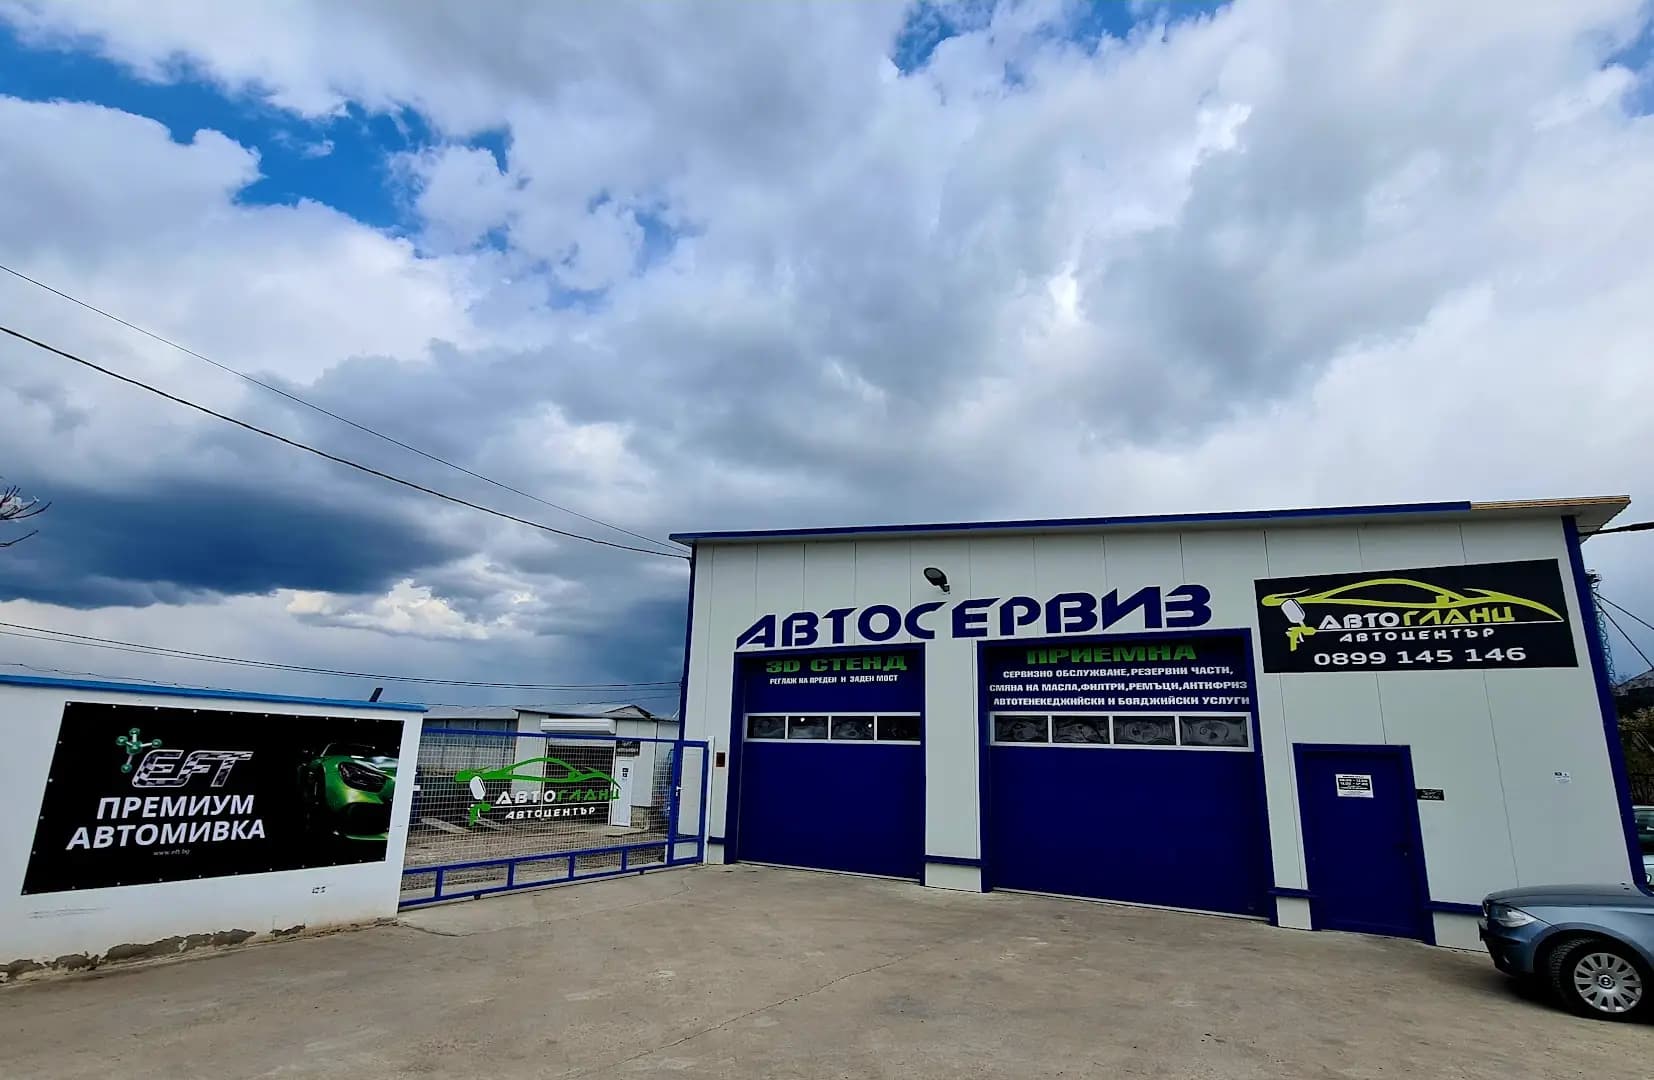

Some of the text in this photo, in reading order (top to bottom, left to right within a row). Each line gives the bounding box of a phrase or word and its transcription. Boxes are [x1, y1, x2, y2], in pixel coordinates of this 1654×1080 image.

[736, 584, 1212, 650] АВТОСЕРВИЗ
[1318, 606, 1515, 630] АВТОГЛАНЦ
[1339, 628, 1495, 643] АВТОЦЕНТЪР
[1027, 646, 1197, 664] ПРИЕМНА
[1313, 647, 1527, 666] 0899 145 146
[810, 656, 908, 672] СТЕНД
[809, 676, 837, 684] ПРЕДЕН
[849, 675, 875, 683] ЗАДЕН
[876, 674, 899, 682] МОСТ
[1003, 670, 1053, 678] СЕРВИЗНО
[989, 684, 1024, 692] СМЯНА
[1025, 684, 1039, 692] НА
[1107, 697, 1116, 705] И
[1118, 696, 1199, 706] БОЯДЖИЙСКИ
[1202, 696, 1250, 705] УСЛУГИ
[131, 749, 254, 788] EFT
[96, 794, 254, 820] ПРЕМИУМ
[505, 806, 596, 820] АВТОЦЕНТЪР
[66, 819, 266, 850] АВТОМИВКА
